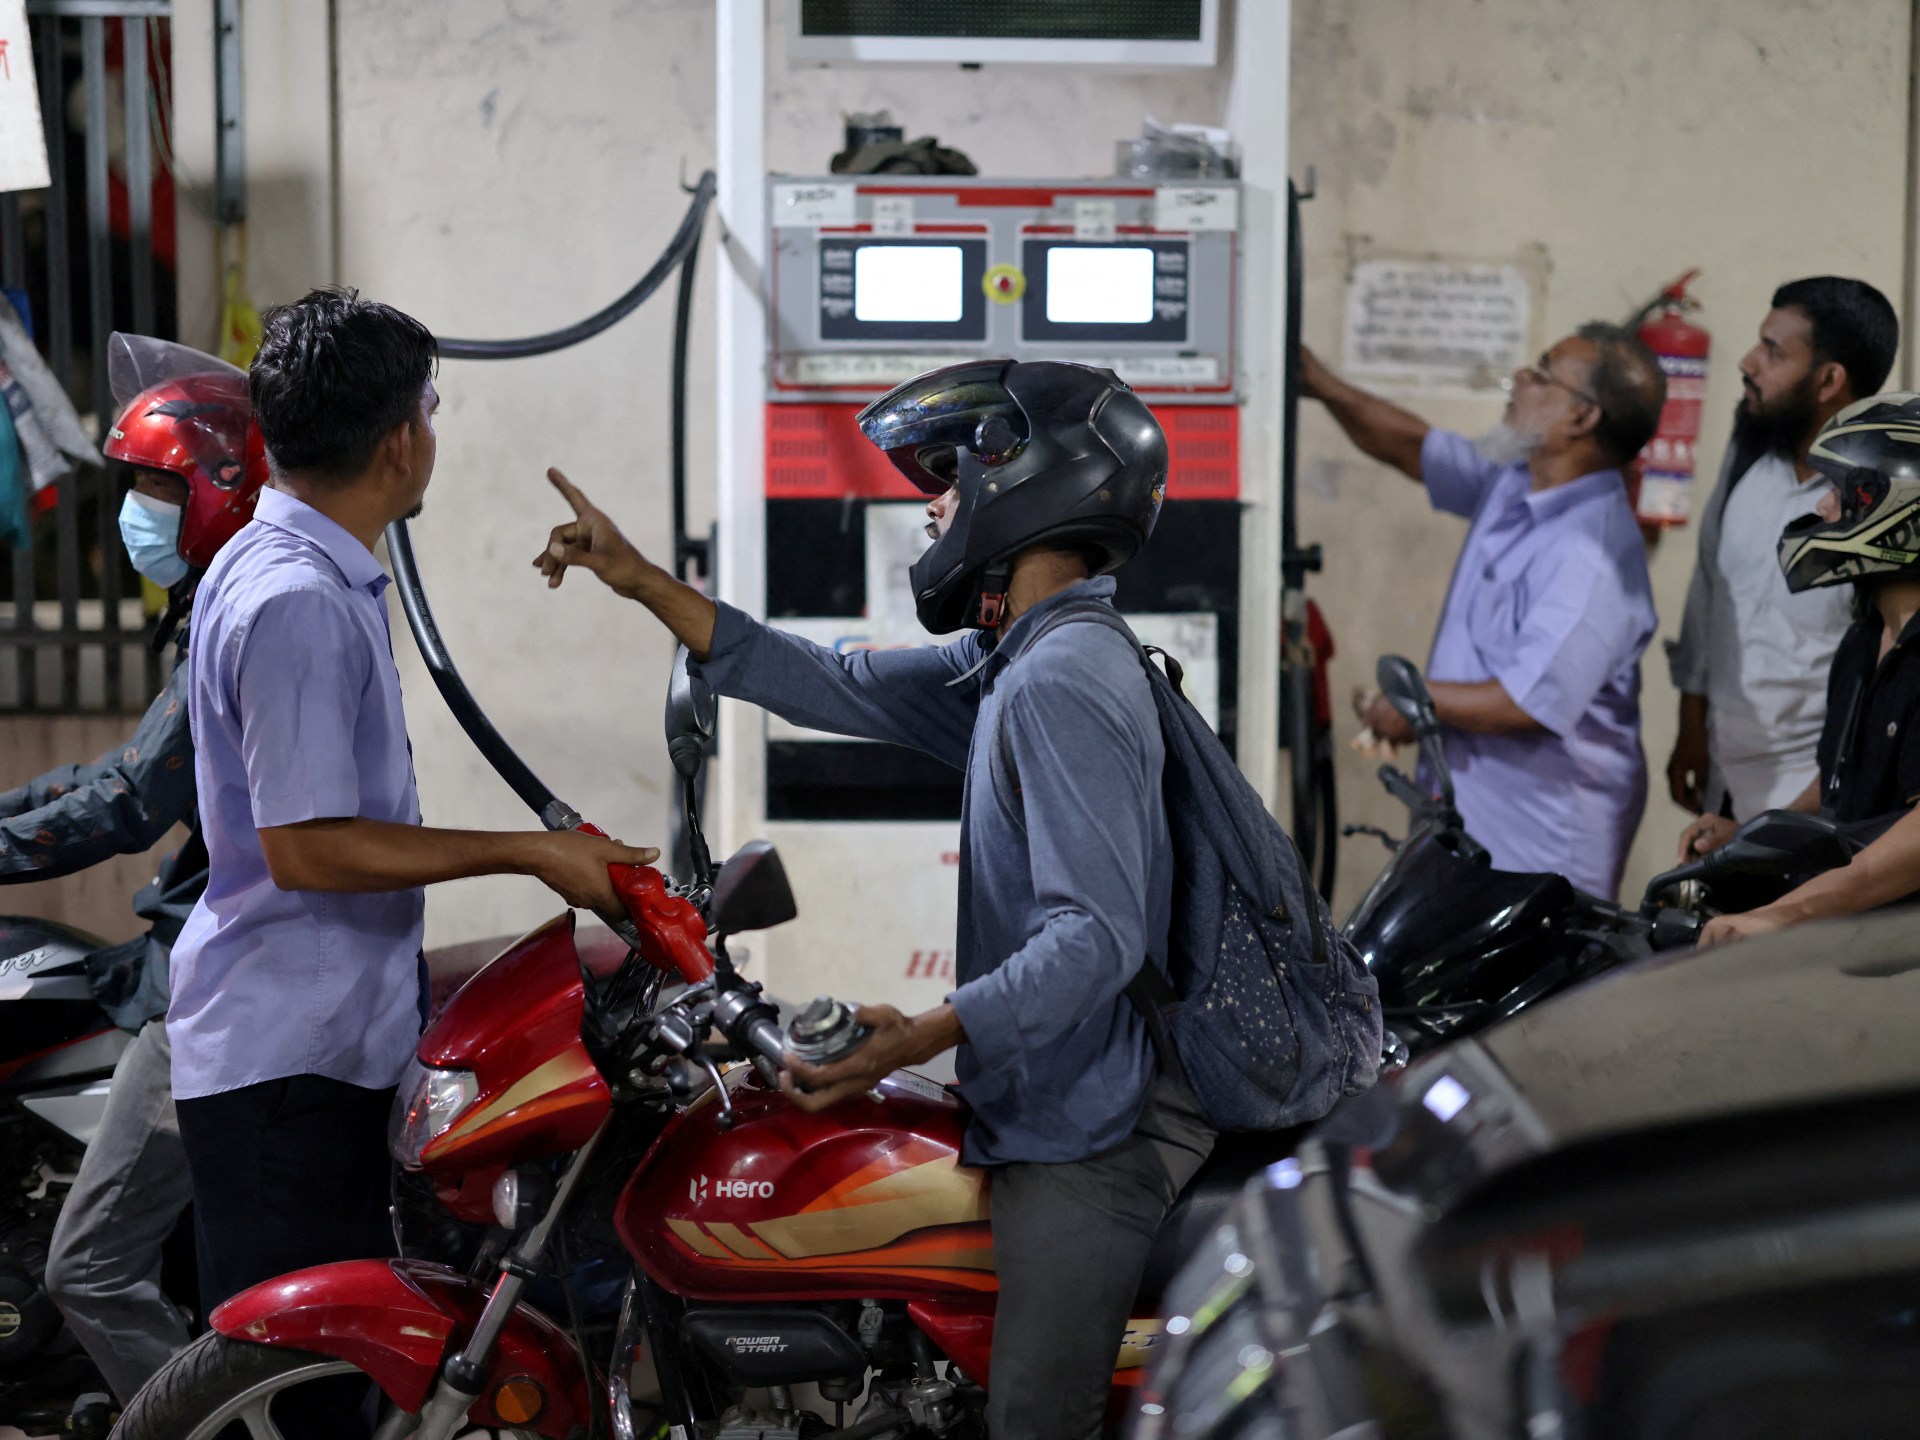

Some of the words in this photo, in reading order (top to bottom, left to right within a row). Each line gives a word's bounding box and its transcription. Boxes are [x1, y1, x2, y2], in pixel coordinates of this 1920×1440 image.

[715, 1180, 775, 1199] Hero
[725, 1336, 780, 1345] POWER
[736, 1345, 788, 1353] START
